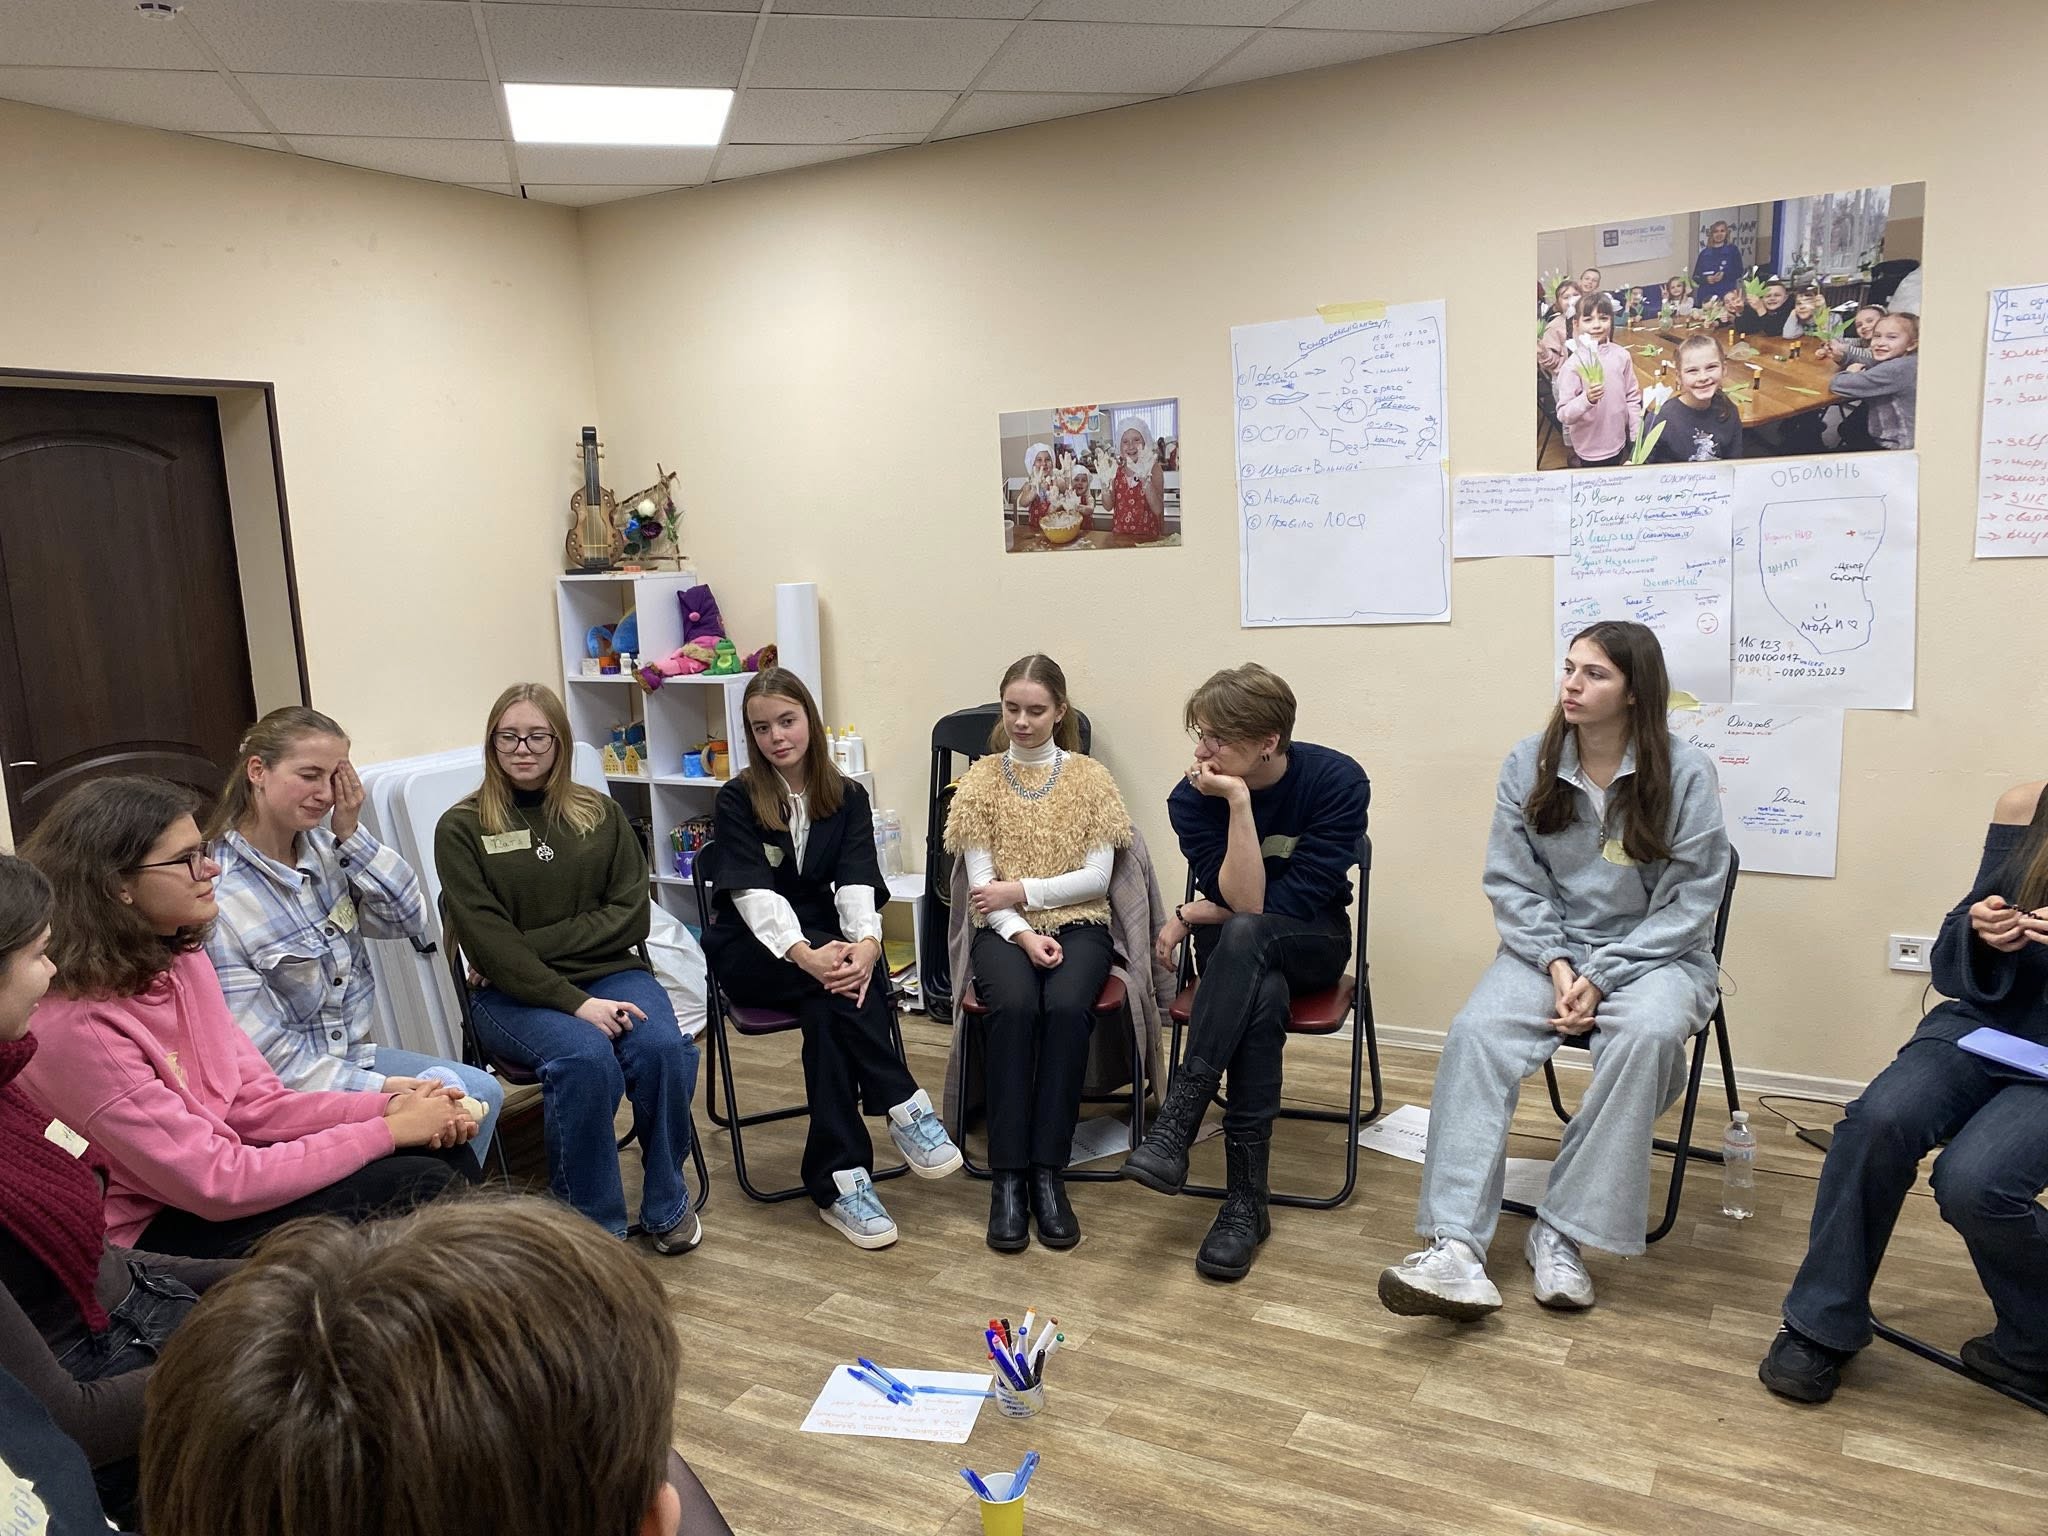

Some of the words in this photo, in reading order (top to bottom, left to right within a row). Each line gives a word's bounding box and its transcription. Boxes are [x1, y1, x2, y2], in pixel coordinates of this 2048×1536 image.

[1260, 425, 1309, 442] СТОП
[1771, 464, 1861, 487] ОБОЛОНЬ
[1264, 488, 1320, 505] Активність
[1739, 636, 1757, 648] 116
[1760, 639, 1781, 653] 123
